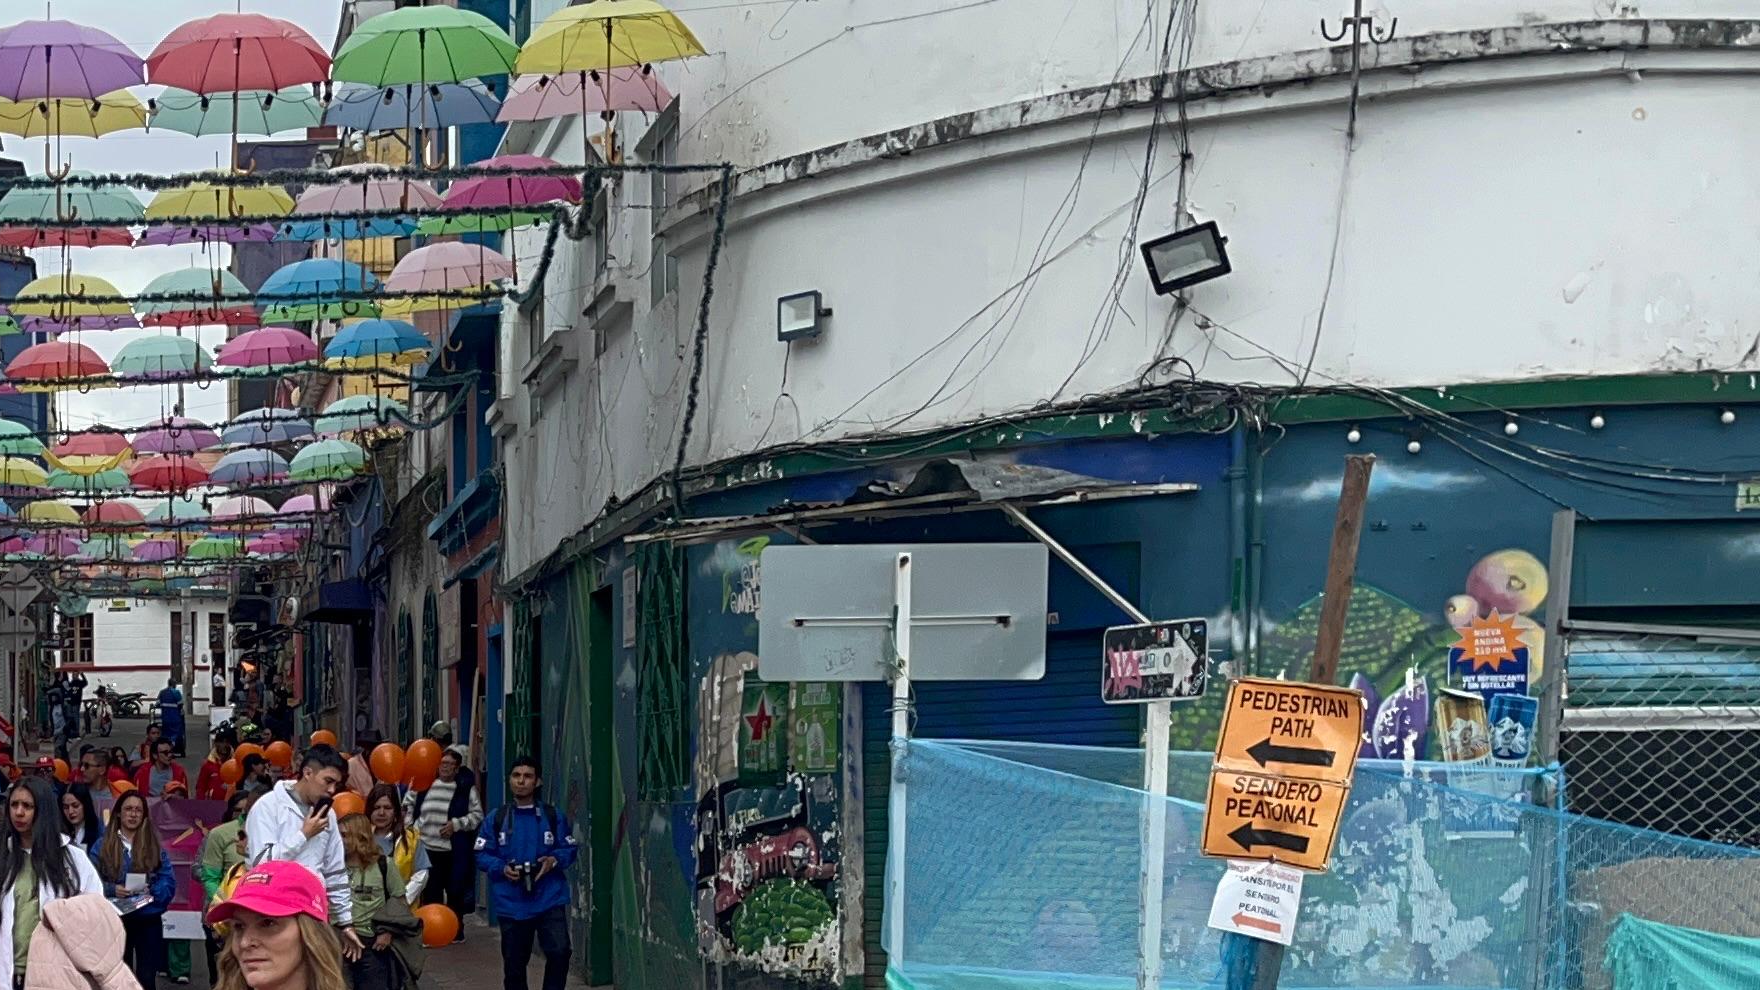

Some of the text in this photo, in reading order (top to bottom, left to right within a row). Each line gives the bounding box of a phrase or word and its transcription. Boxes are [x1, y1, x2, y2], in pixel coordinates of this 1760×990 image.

[1239, 689, 1349, 719] PEDESTRIAN
[1270, 716, 1315, 739] PATH
[1232, 776, 1323, 802] SENDERO
[1225, 798, 1320, 828] PEATONAL
